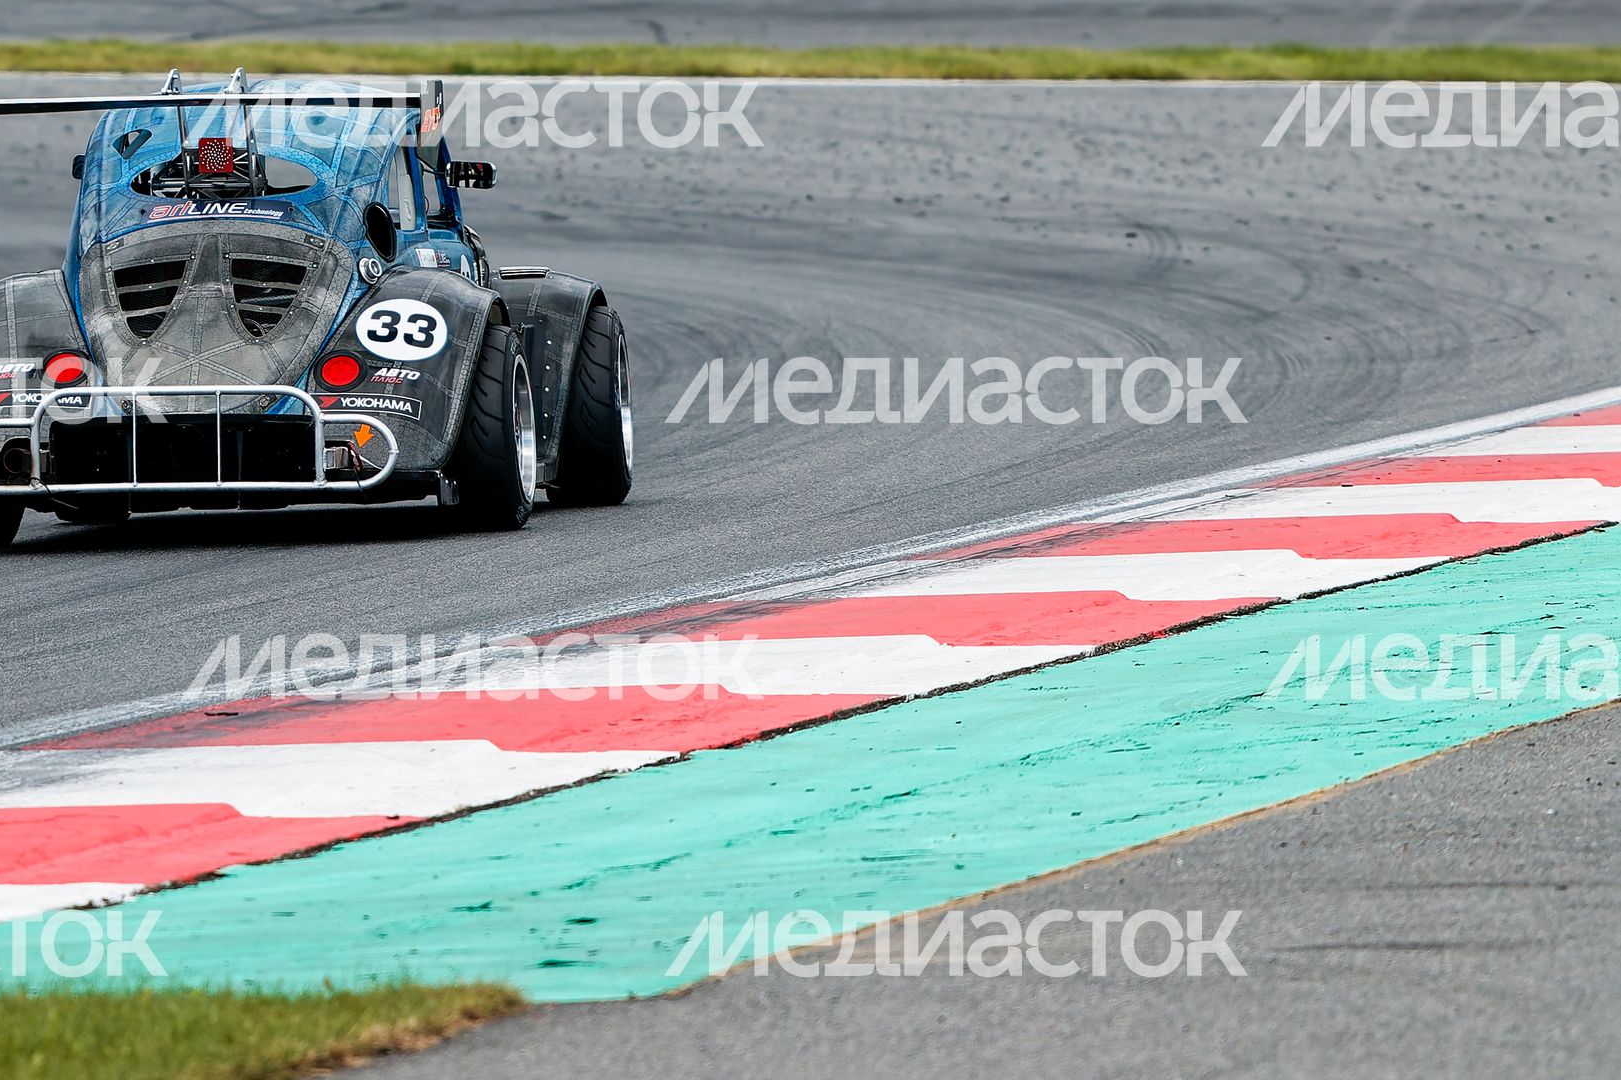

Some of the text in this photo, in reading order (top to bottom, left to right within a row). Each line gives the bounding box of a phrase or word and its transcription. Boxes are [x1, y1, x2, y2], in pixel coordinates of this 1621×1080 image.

[244, 207, 284, 218] technology
[367, 310, 437, 349] 33
[370, 376, 404, 385] ПЛЮС
[374, 367, 421, 381] АВТО
[12, 393, 83, 405] YOKOMA
[340, 397, 413, 413] YOKOHAMA
